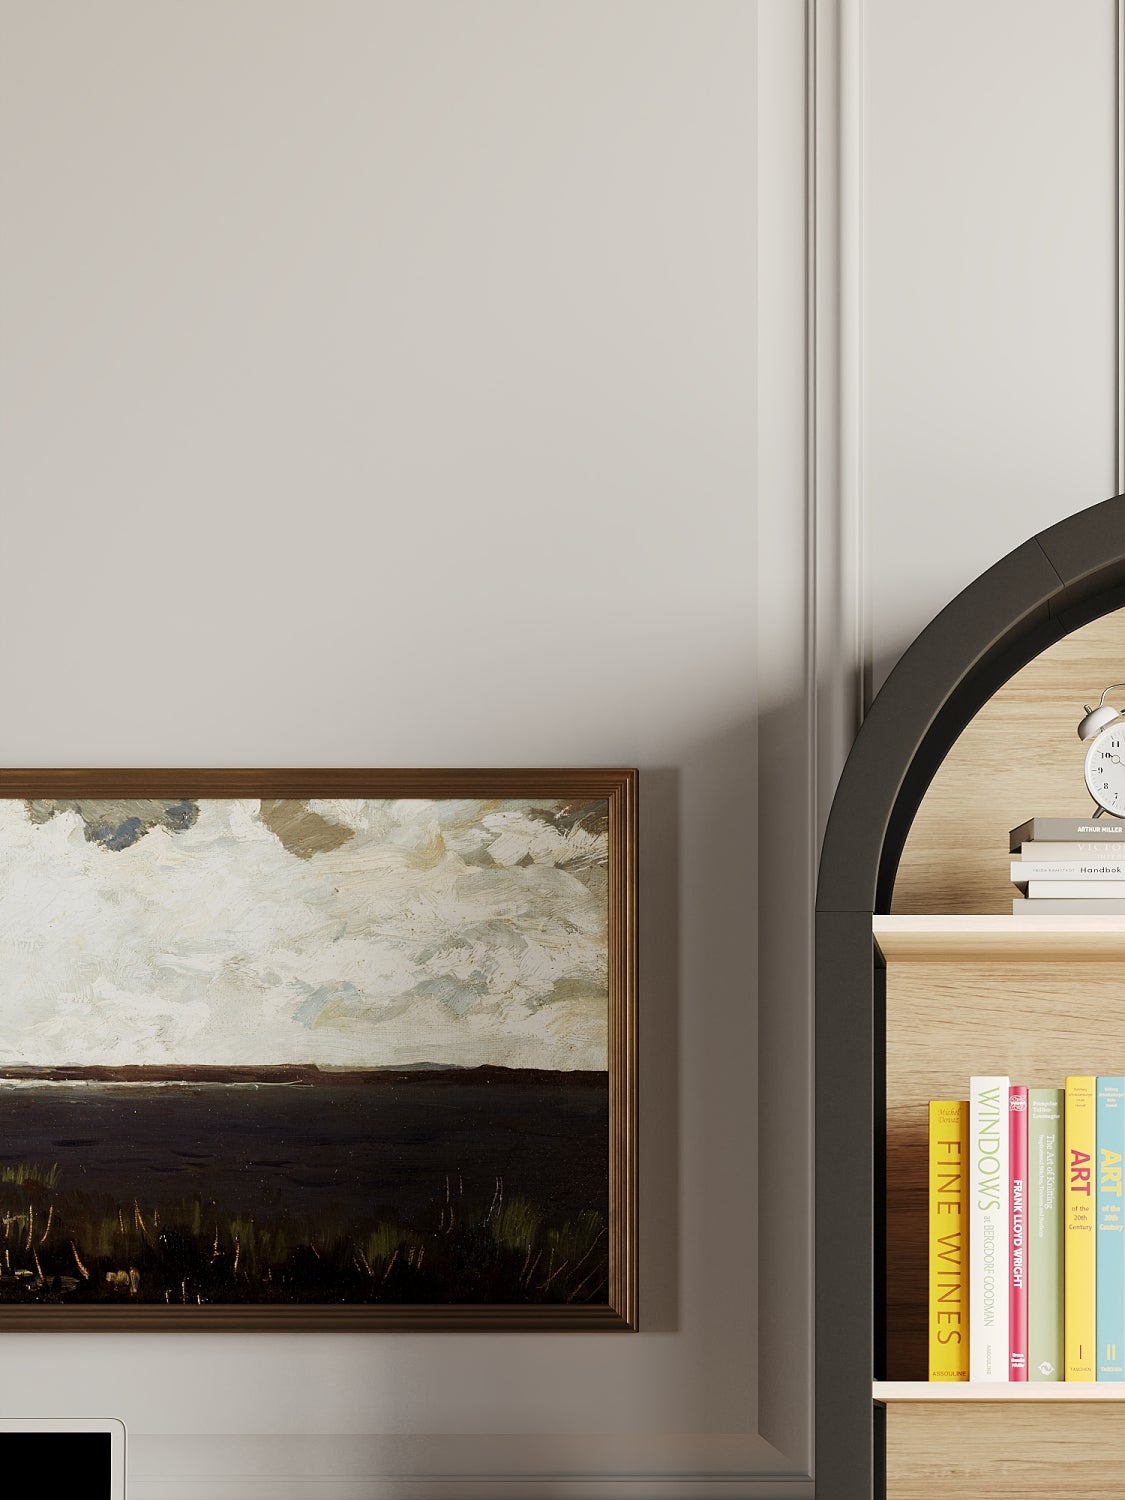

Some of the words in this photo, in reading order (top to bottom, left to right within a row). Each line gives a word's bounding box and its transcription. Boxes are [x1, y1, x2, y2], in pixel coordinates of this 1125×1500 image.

[977, 1087, 1001, 1211] WINDOWS
[1070, 1149, 1091, 1197] ART
[1101, 1148, 1122, 1197] ART
[937, 1140, 962, 1215] FINE
[1013, 1179, 1023, 1213] FRANK
[983, 1215, 993, 1224] at
[1013, 1214, 1023, 1247] LLOYD
[1068, 1223, 1092, 1232] Century
[1073, 1214, 1088, 1222] 20th
[983, 1225, 995, 1275] BERGDORF
[1013, 1248, 1023, 1288] WRIGHT
[937, 1232, 962, 1345] WINES
[983, 1276, 995, 1327] GOODMAN
